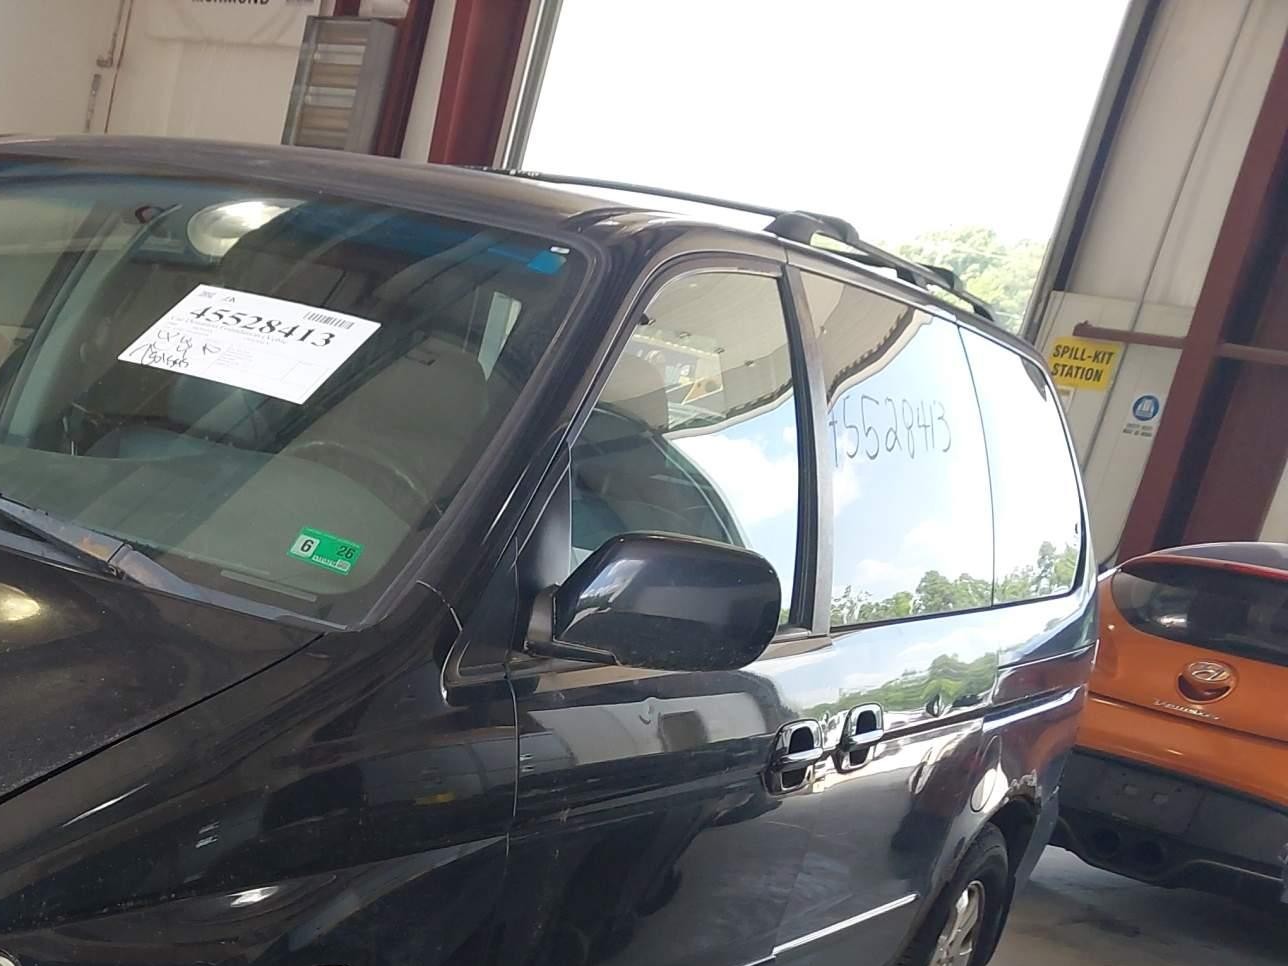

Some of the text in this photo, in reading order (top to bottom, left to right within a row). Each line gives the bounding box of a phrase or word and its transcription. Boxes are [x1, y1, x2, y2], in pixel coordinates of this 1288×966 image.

[190, 305, 336, 348] 45528413
[1052, 344, 1114, 365] SPILL-KIT
[1051, 363, 1103, 382] STATION
[300, 539, 356, 560] 6 26
